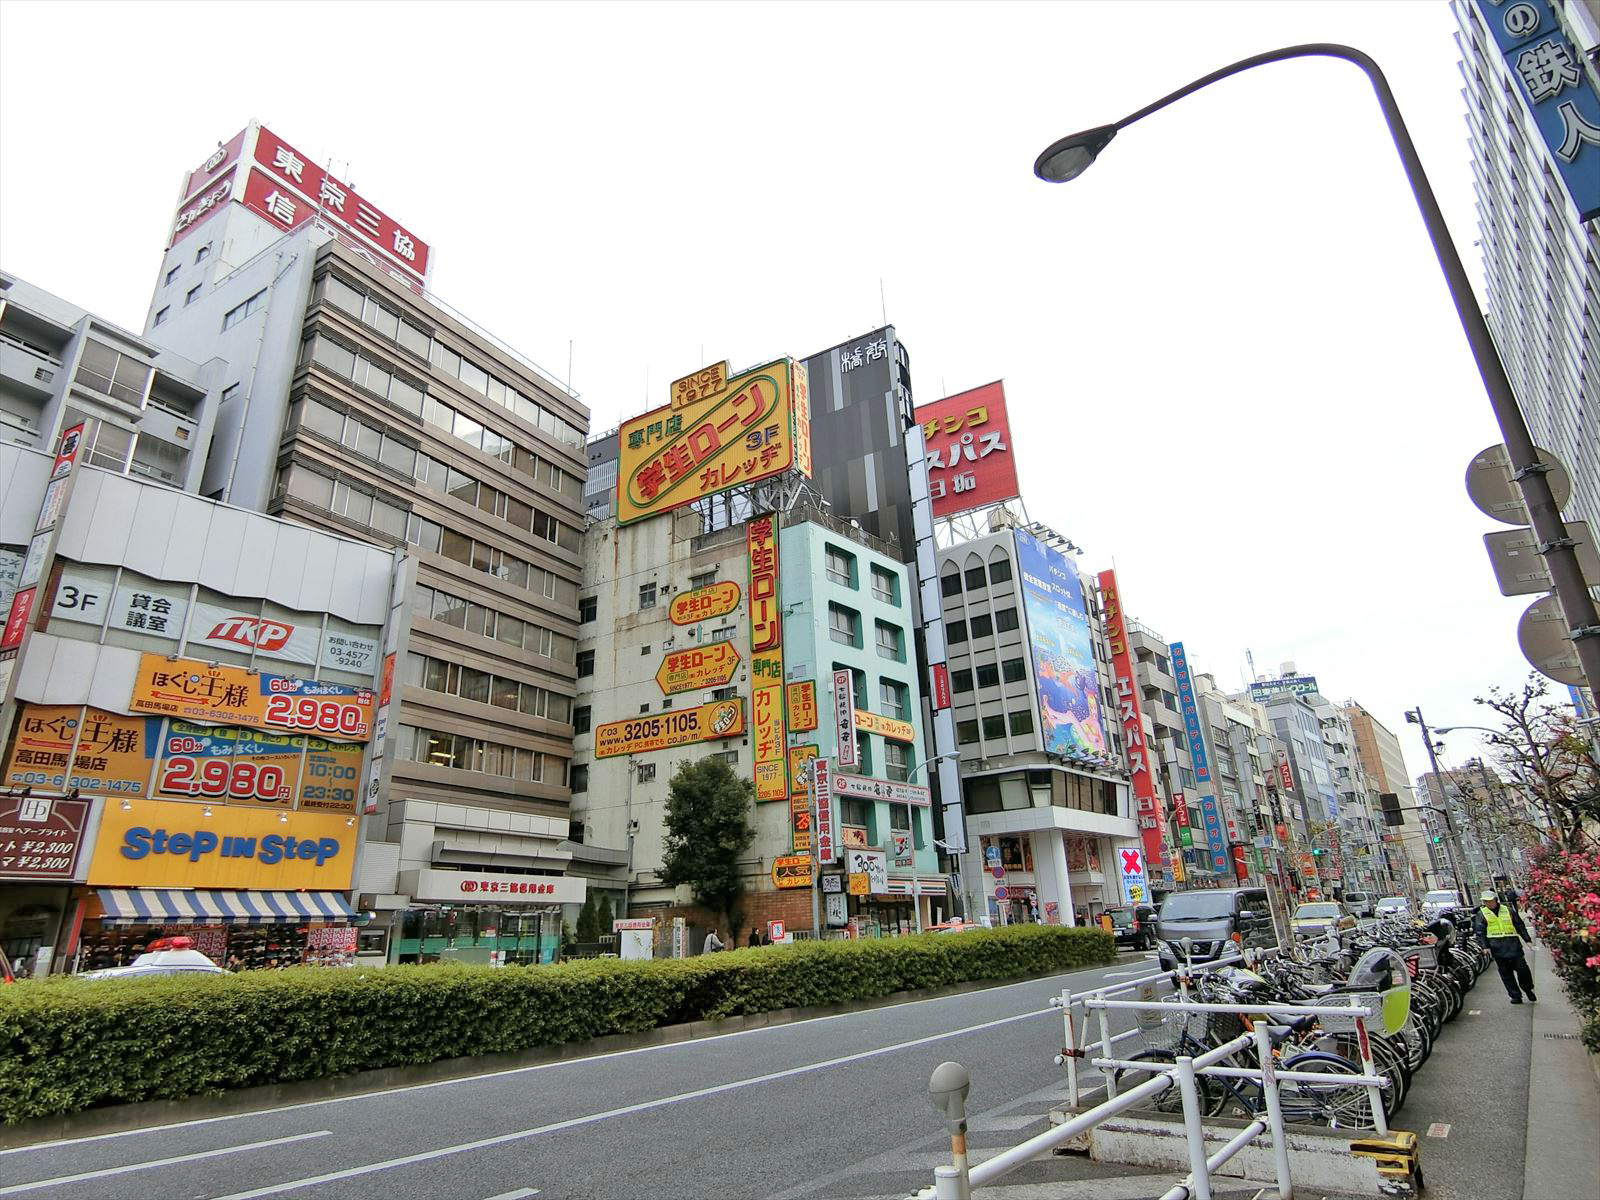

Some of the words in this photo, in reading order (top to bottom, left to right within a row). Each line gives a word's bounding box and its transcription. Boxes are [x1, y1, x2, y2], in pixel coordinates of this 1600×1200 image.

[1487, 0, 1600, 158] の鉄人
[265, 191, 296, 225] 信
[272, 146, 415, 261] 東京三協
[676, 379, 723, 405] 1977
[678, 366, 720, 393] SINCE
[628, 414, 684, 449] 専門店
[636, 383, 765, 499] 学生ローン
[746, 424, 780, 451] 3F
[927, 430, 1007, 470] スパス
[751, 519, 780, 649] 学生ローン
[57, 585, 98, 612] 3F
[130, 593, 172, 615] 貸会
[677, 589, 733, 615] 学生ローン
[126, 611, 168, 633] 議室
[214, 618, 287, 647] TKP
[330, 647, 369, 660] 03-4577
[336, 657, 362, 668] -9240
[667, 646, 725, 672] 学生ローン
[752, 658, 781, 679] 専門店
[136, 700, 179, 712] 高田馬場店
[265, 694, 367, 734] 2,980円
[801, 684, 812, 727] 学生ローン
[607, 728, 618, 736] 03
[756, 690, 774, 759] カレッヂ
[855, 714, 873, 727] ローン
[1118, 676, 1146, 776] エスパス
[24, 715, 139, 754] ほぐしの王様
[169, 737, 203, 754] 60分
[15, 749, 108, 771] 高田馬場店
[210, 744, 264, 755] もみほぐし
[160, 756, 291, 801] 2,980円
[309, 763, 355, 779] 10:00
[757, 764, 779, 774] SINCE
[24, 772, 141, 793] 03-6302-1475
[304, 785, 354, 801] 23:30
[816, 760, 832, 861] 東京三協信用金庫
[21, 841, 74, 854] ¥2,300
[18, 856, 70, 869] ¥2,300
[781, 866, 811, 877] 人気
[480, 881, 555, 894] 東京三協信用金庫
